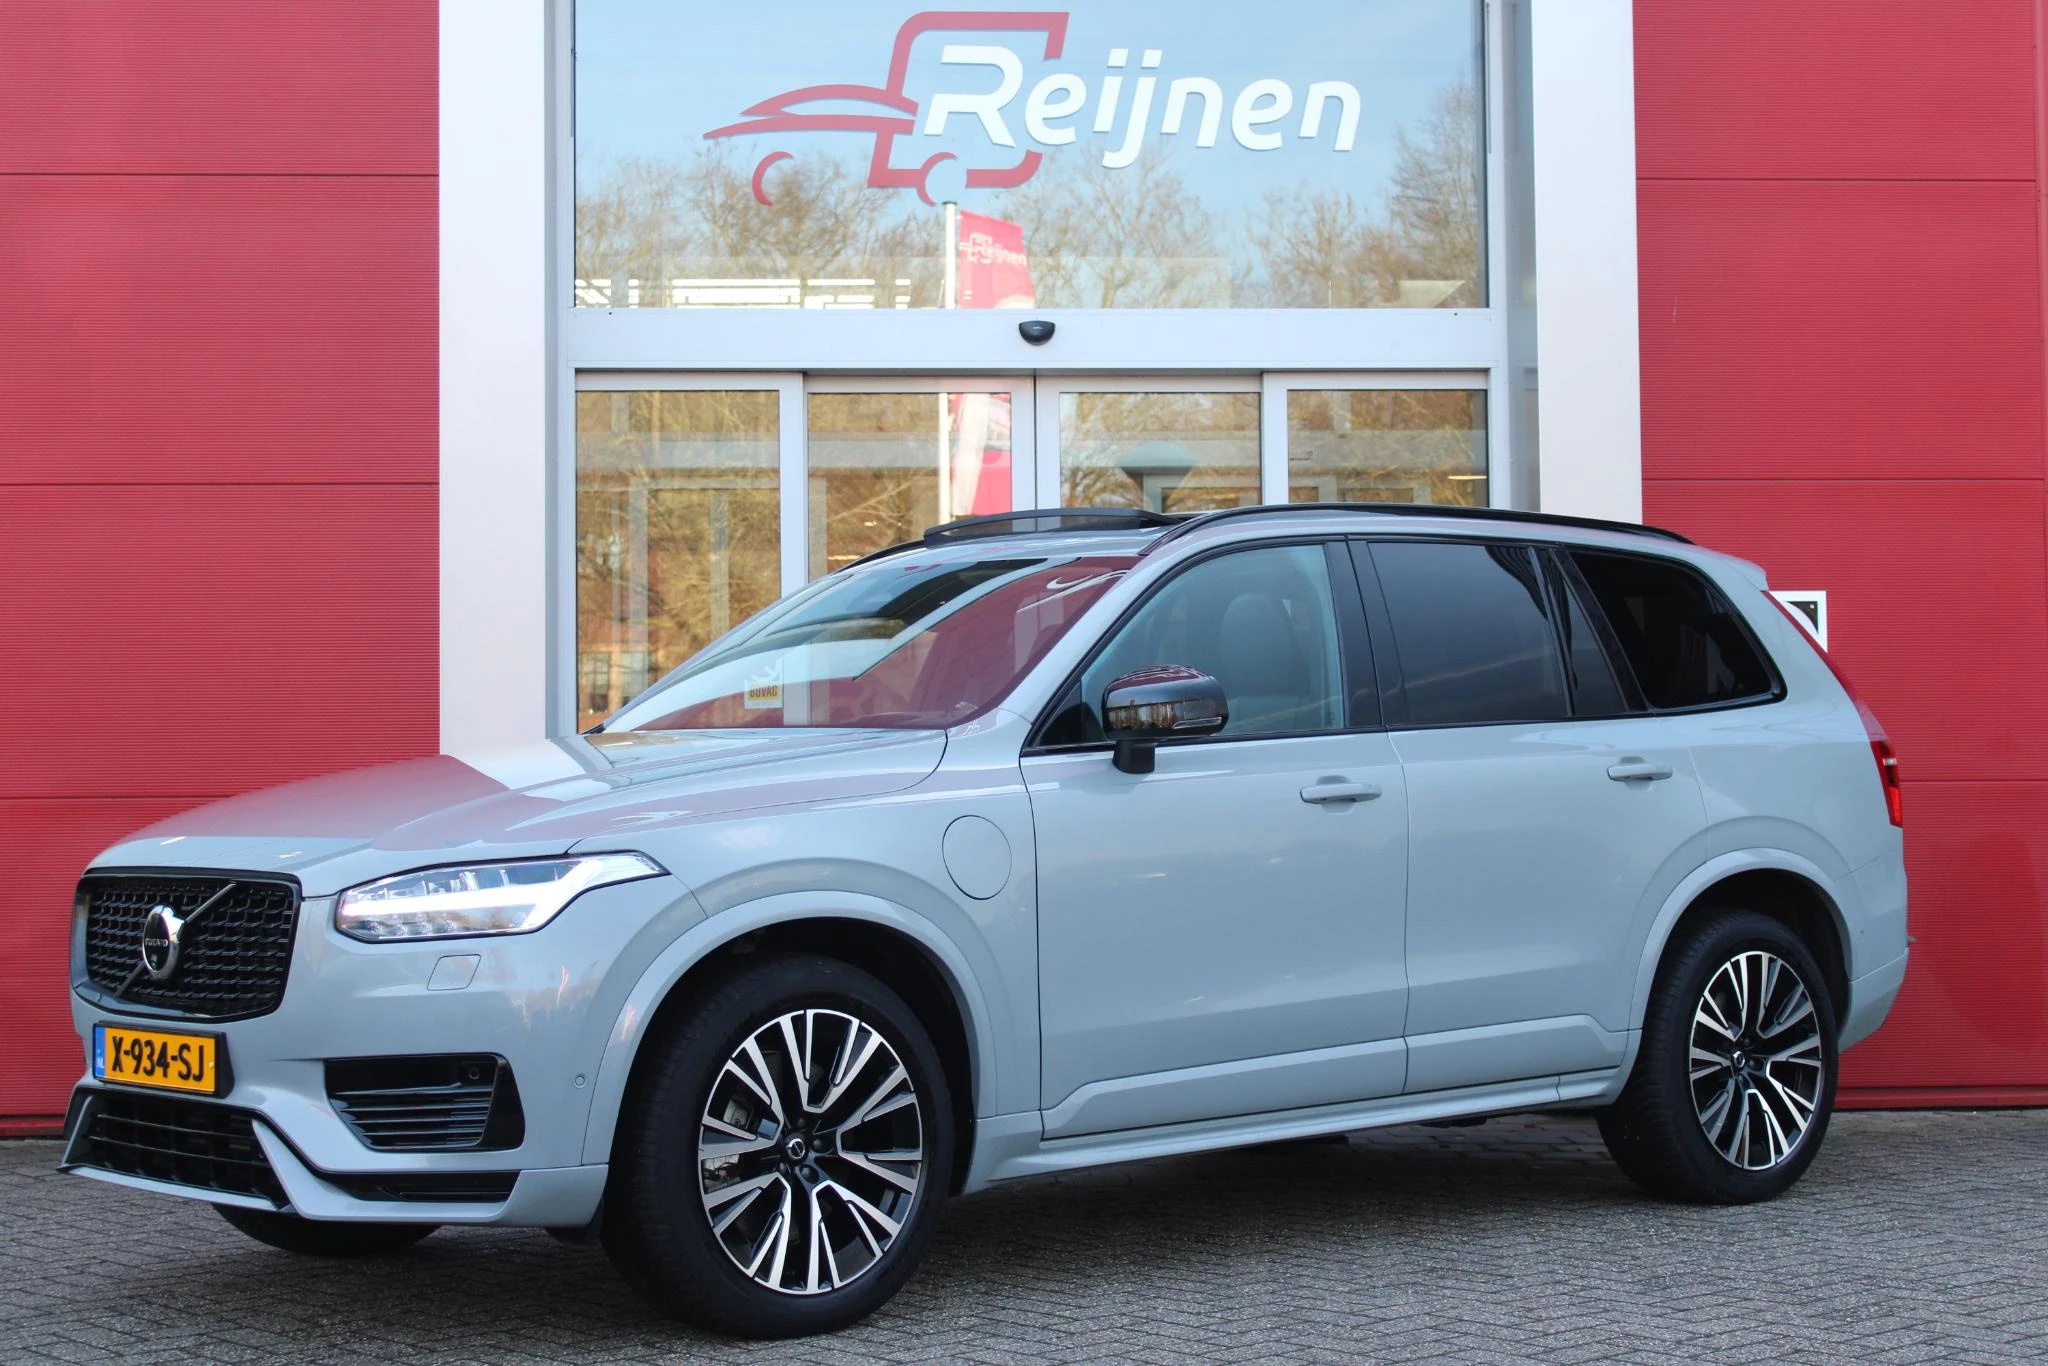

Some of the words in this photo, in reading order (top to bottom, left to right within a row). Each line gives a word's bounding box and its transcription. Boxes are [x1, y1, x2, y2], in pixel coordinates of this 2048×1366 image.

[923, 45, 1361, 169] Reijnen
[750, 685, 778, 698] BOVAG
[112, 1035, 204, 1082] X-934-SJ
